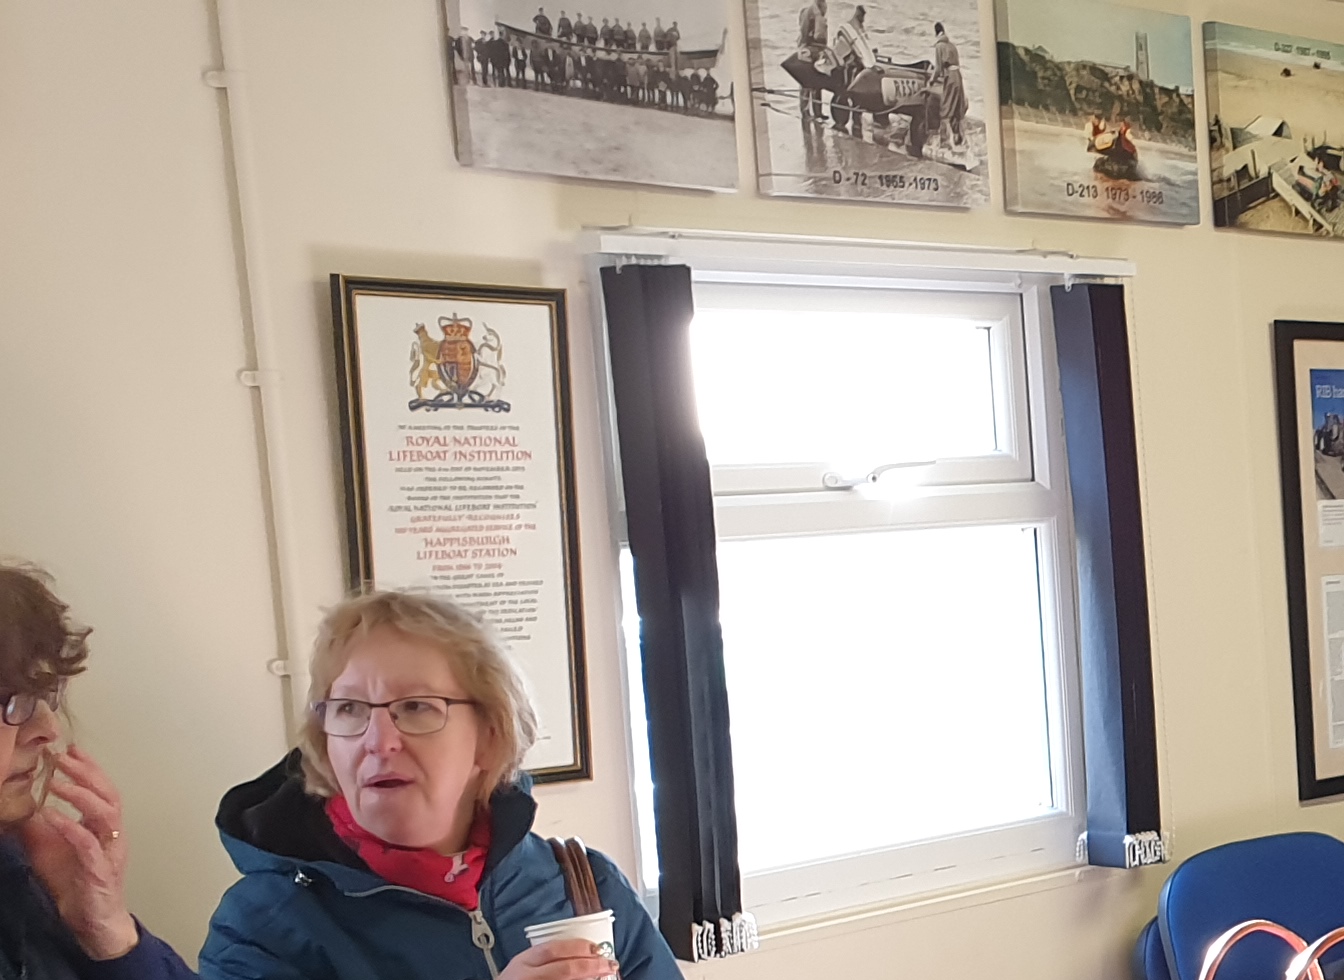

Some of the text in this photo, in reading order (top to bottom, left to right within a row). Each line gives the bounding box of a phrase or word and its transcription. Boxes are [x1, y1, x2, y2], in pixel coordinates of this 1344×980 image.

[1066, 183, 1098, 199] D-213
[1105, 186, 1130, 202] 1973
[405, 435, 519, 447] ROYAL NATIONAL
[388, 449, 533, 463] LIFEBOAT INSTITUTION
[423, 535, 510, 549] HAPPISBURGH
[416, 547, 518, 560] LIFEBOAT STATION
